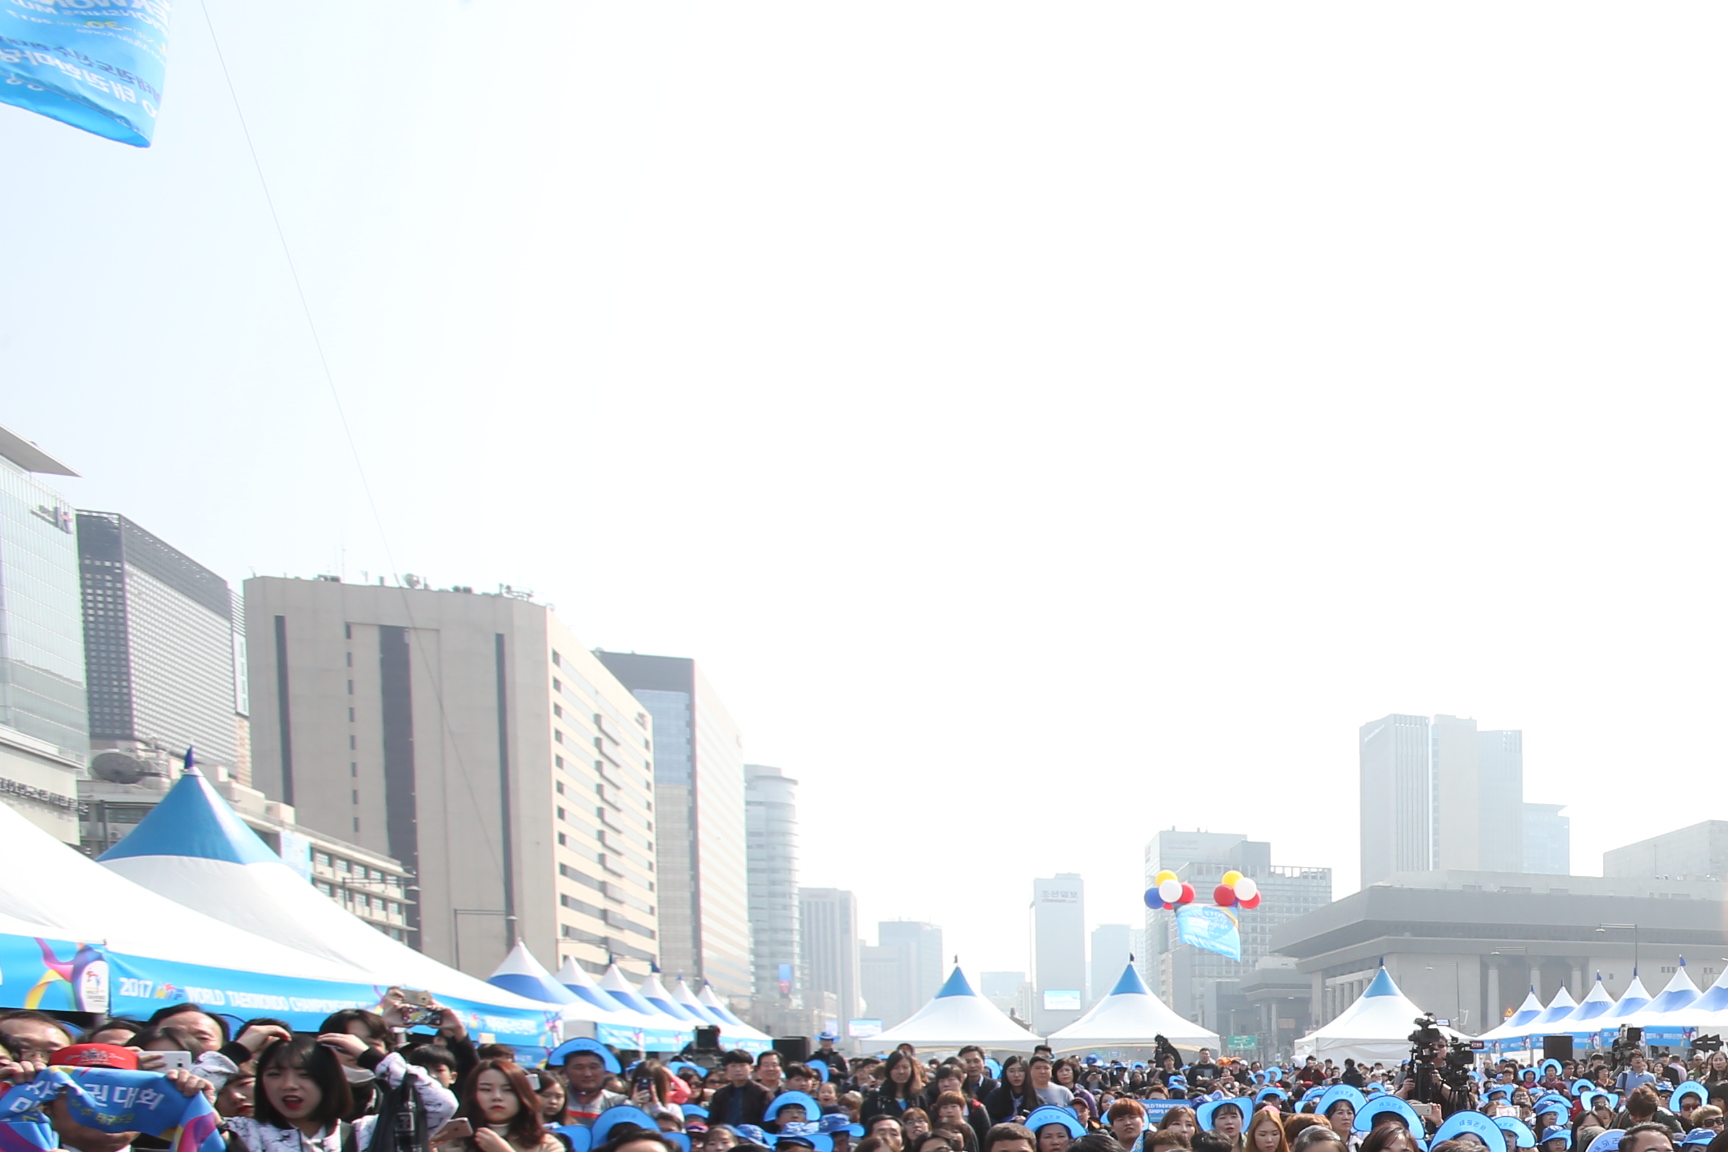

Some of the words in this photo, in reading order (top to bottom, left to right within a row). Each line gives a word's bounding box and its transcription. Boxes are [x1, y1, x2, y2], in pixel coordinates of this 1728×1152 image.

[119, 977, 153, 998] 2017
[186, 986, 225, 1006] WORLD
[226, 990, 288, 1012] TAEKWONDO
